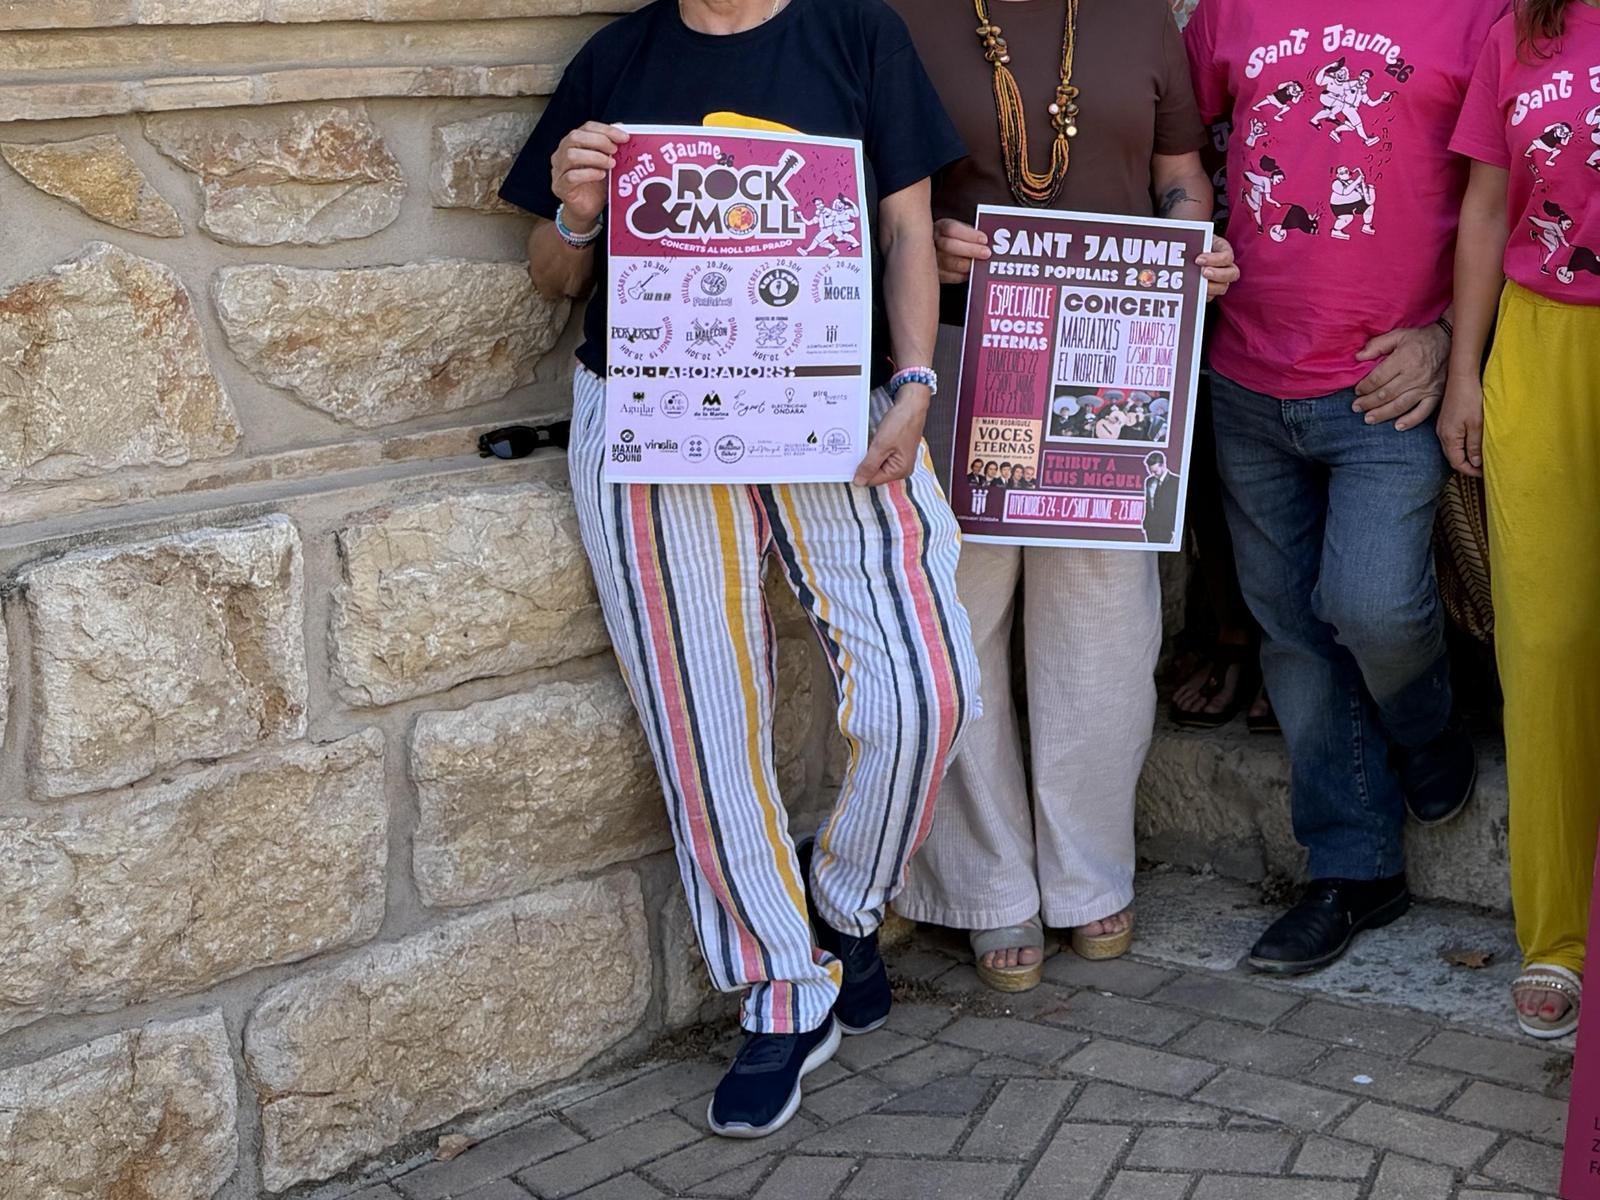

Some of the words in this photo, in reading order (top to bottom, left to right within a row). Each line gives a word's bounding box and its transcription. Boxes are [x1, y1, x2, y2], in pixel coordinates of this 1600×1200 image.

[1245, 28, 1309, 79] Sant
[1323, 24, 1400, 65] Jaume
[1384, 57, 1415, 83] 26
[1511, 70, 1574, 126] Sant
[618, 152, 656, 198] Sant
[660, 141, 722, 164] Jaume
[677, 155, 799, 201] ROCK
[660, 238, 706, 253] CONCERTS
[707, 246, 719, 254] AL
[719, 245, 744, 254] MOLL
[745, 245, 761, 253] DEL
[763, 240, 793, 251] PRADO
[992, 228, 1073, 259] SANT
[1084, 235, 1187, 268] JAUME
[824, 276, 833, 286] LA
[989, 261, 1040, 278] FESTES
[1044, 264, 1119, 283] POPULARS
[823, 286, 861, 301] MOCHA
[988, 284, 1053, 319] ESPECTACLE
[1064, 293, 1179, 318] CONCERT
[990, 319, 1044, 335] VOCES
[1060, 316, 1120, 351] MARIATXIS
[1128, 320, 1165, 346] DIMARTS
[1166, 323, 1176, 347] 21
[982, 334, 1048, 351] ETERNAS
[1057, 351, 1068, 381] EL
[1072, 350, 1116, 384] NORTEÑO
[619, 403, 655, 414] Aguilar
[978, 427, 1033, 442] VOCES
[611, 444, 642, 454] MAXIM
[974, 441, 1035, 454] ETERNAS
[611, 453, 642, 463] SOUND
[1046, 455, 1100, 470] TRIBUT
[1105, 458, 1116, 471] A
[1044, 470, 1078, 486] LUIS
[1083, 472, 1142, 488] MIGUEL
